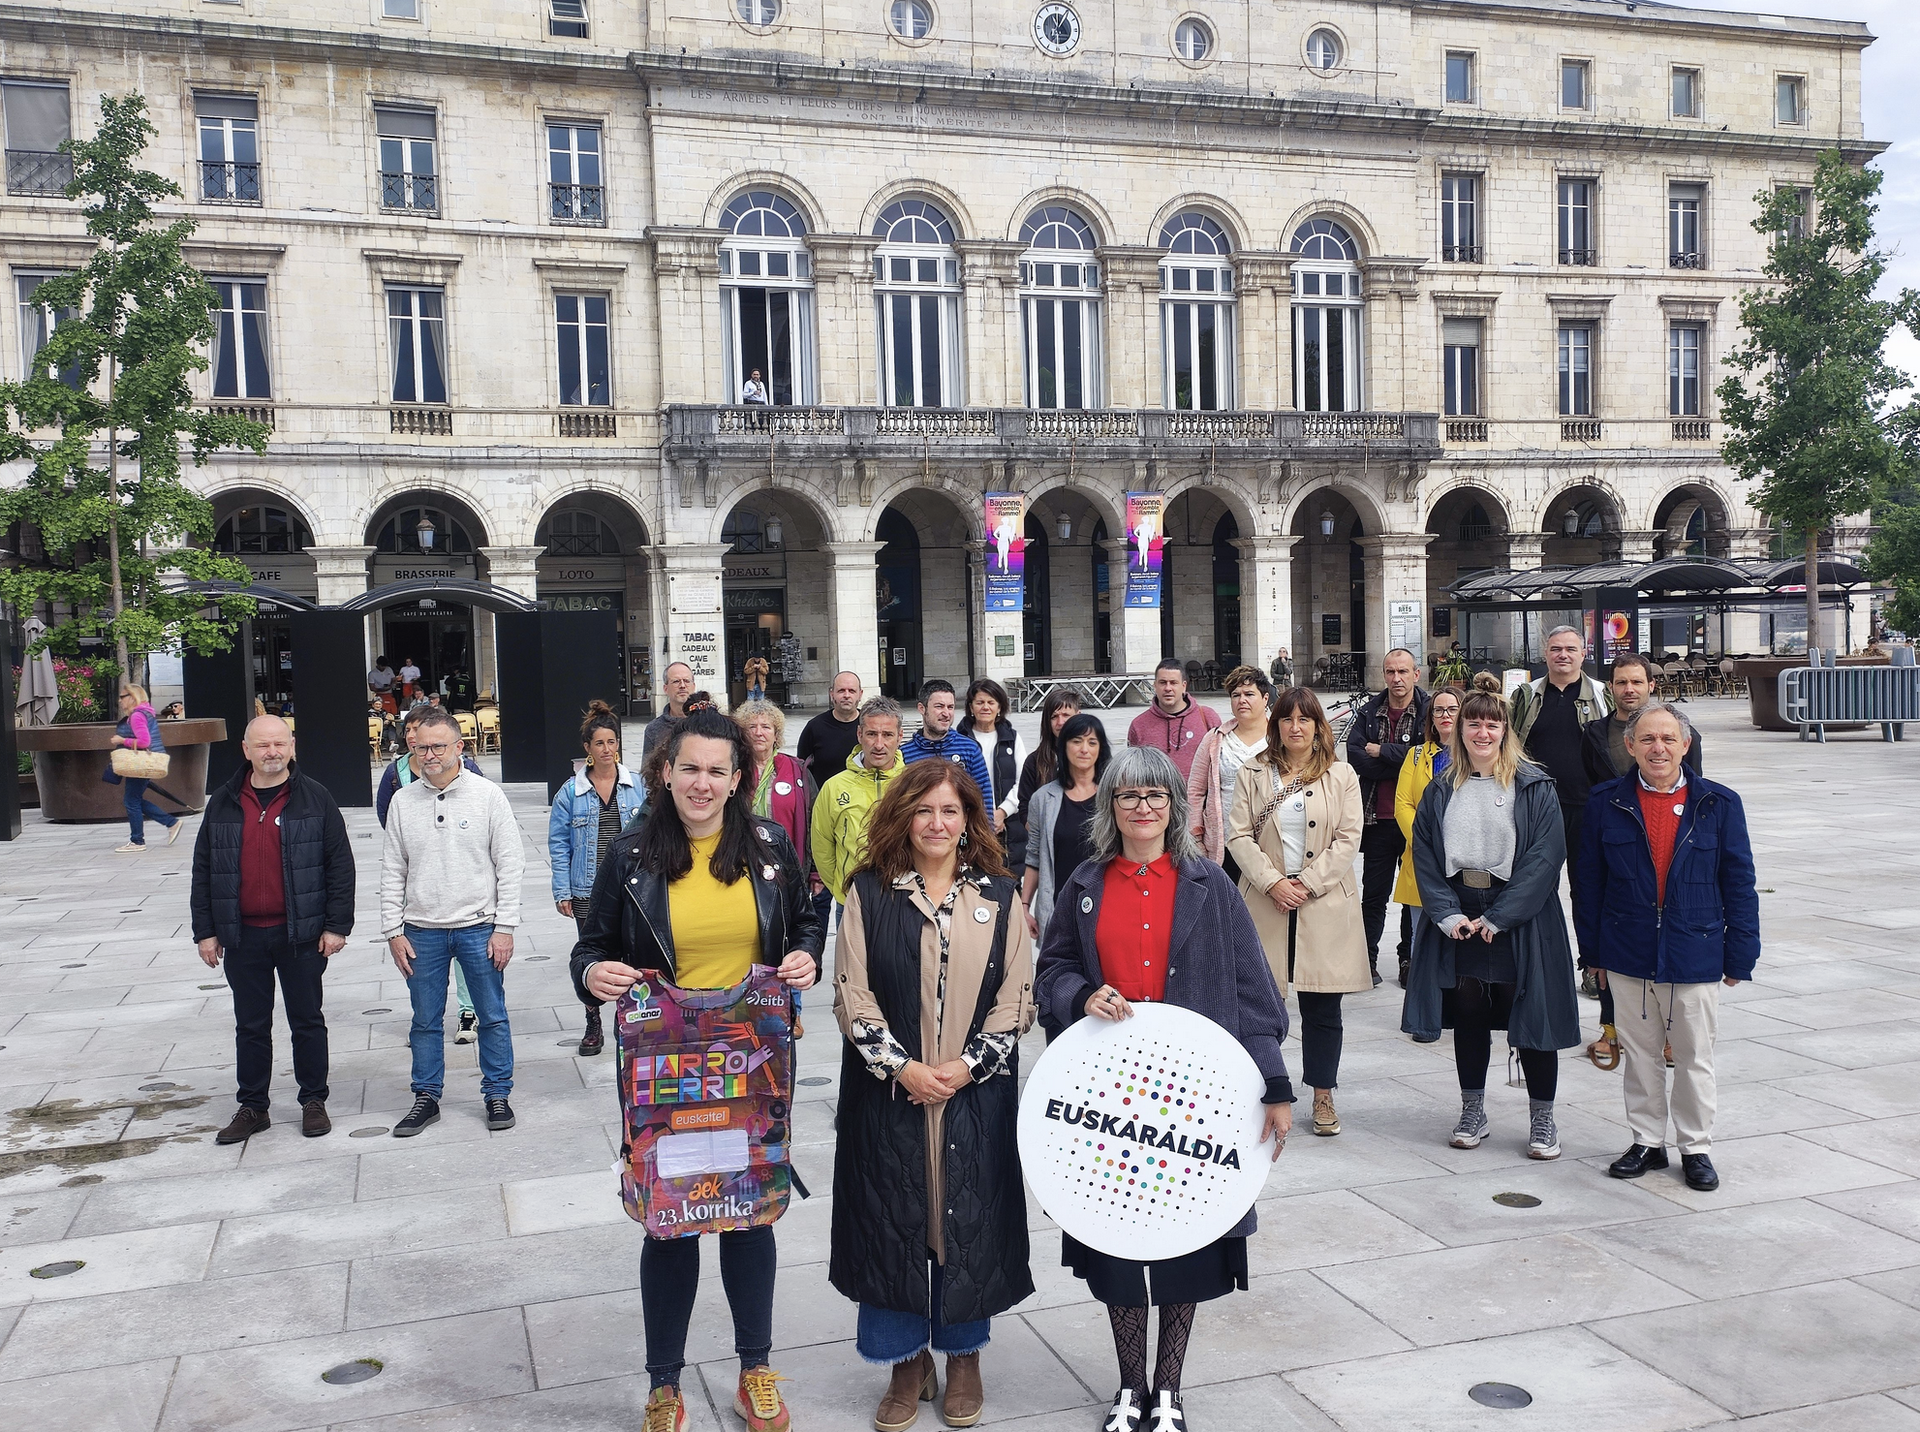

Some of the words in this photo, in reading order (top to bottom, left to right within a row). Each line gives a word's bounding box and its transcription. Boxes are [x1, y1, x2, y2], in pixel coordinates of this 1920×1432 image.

[690, 89, 712, 100] LES
[722, 91, 769, 104] ARMÉES
[780, 96, 794, 106] ET
[801, 97, 837, 109] LEURS
[847, 99, 883, 112] CHEFS
[894, 104, 907, 114] LE
[1010, 111, 1023, 121] DE
[1033, 113, 1045, 123] LA
[1126, 119, 1138, 129] LE
[861, 112, 887, 121] ONT
[994, 121, 1011, 129] DE
[1019, 122, 1034, 131] LA
[1042, 124, 1088, 134] PATRIE
[1147, 131, 1215, 142] NOVEMBRE
[250, 570, 282, 581] CAFE
[395, 569, 456, 580] BRASSERIE
[558, 570, 595, 580] LOTO
[722, 567, 770, 577] ADEAUX
[542, 595, 612, 611] TABAC
[683, 632, 715, 642] TABAC
[681, 644, 717, 653] CADEAUX
[689, 655, 708, 663] CAVE
[691, 668, 716, 677] GARES
[760, 994, 785, 1007] eitb
[675, 1110, 726, 1126] euskaltel
[1044, 1098, 1241, 1170] EUSKARALDIA
[688, 1174, 723, 1201] aek
